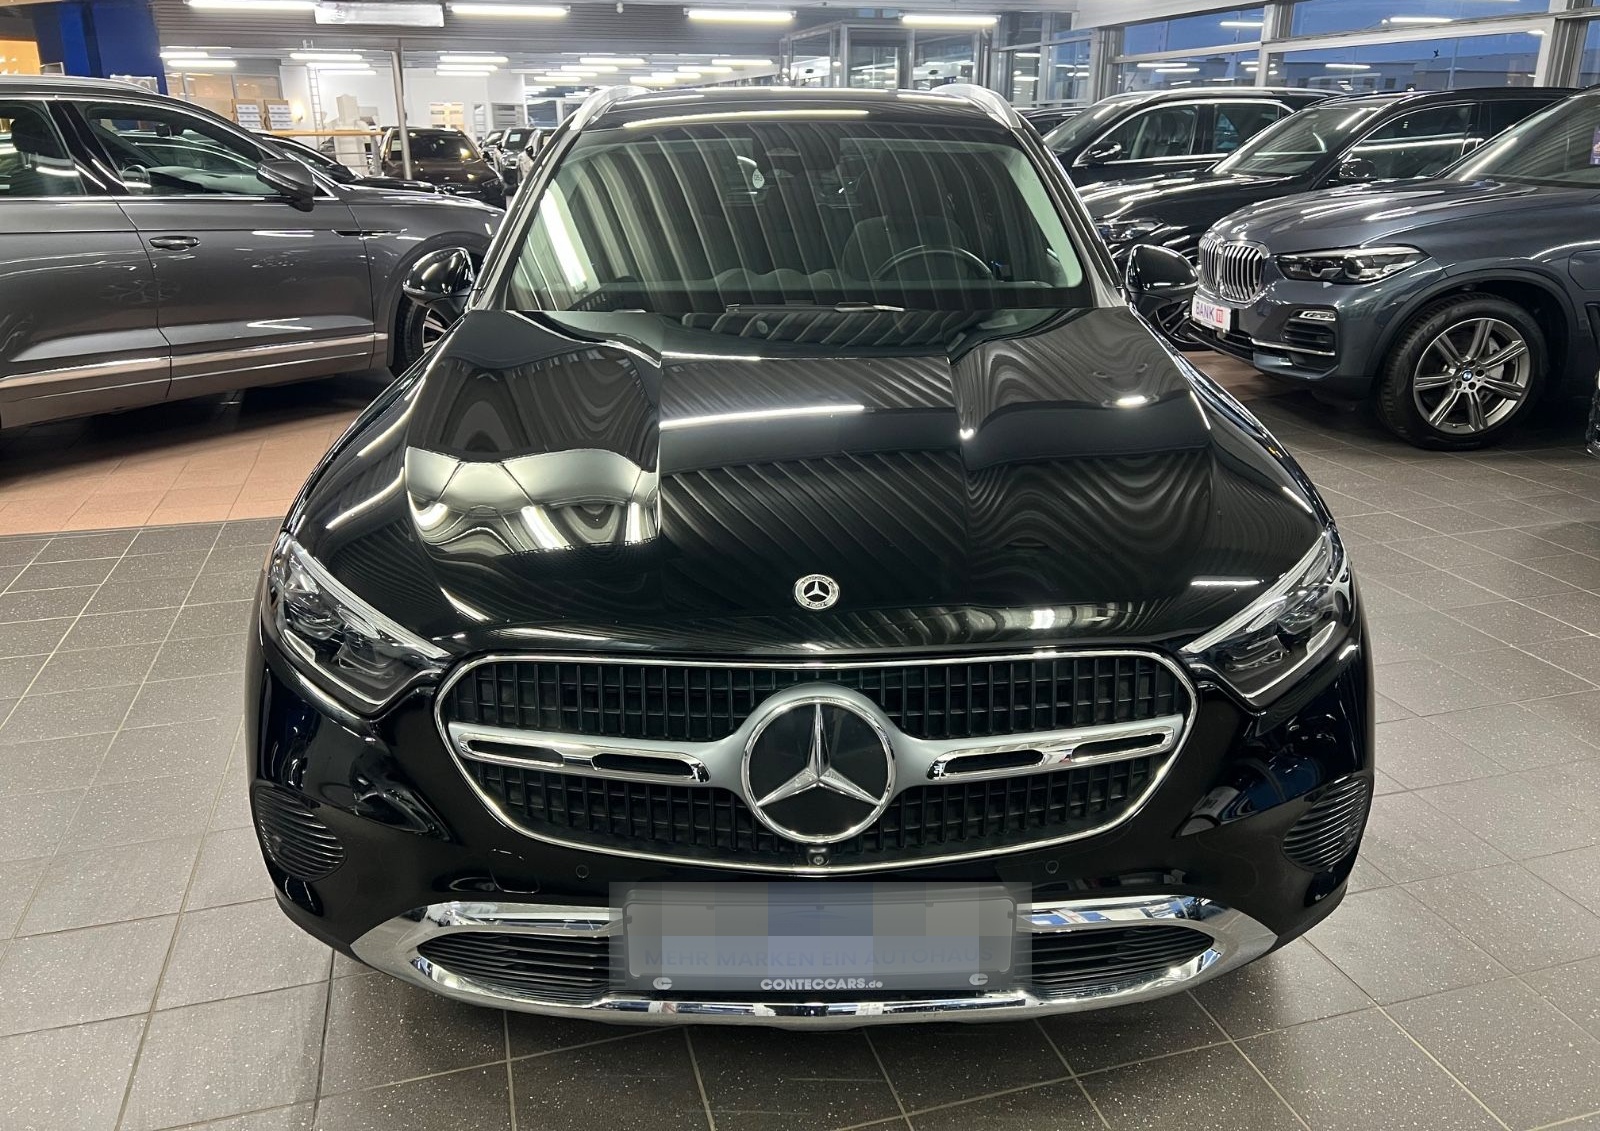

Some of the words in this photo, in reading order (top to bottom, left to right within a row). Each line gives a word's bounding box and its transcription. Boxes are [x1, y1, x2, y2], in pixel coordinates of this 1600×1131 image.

[1195, 301, 1215, 322] BANK
[645, 950, 709, 966] MEHR
[717, 950, 814, 967] MARKEN
[822, 951, 857, 966] EIN
[864, 946, 993, 966] AUTOHAUS
[760, 977, 884, 990] CONTECCARS.de
